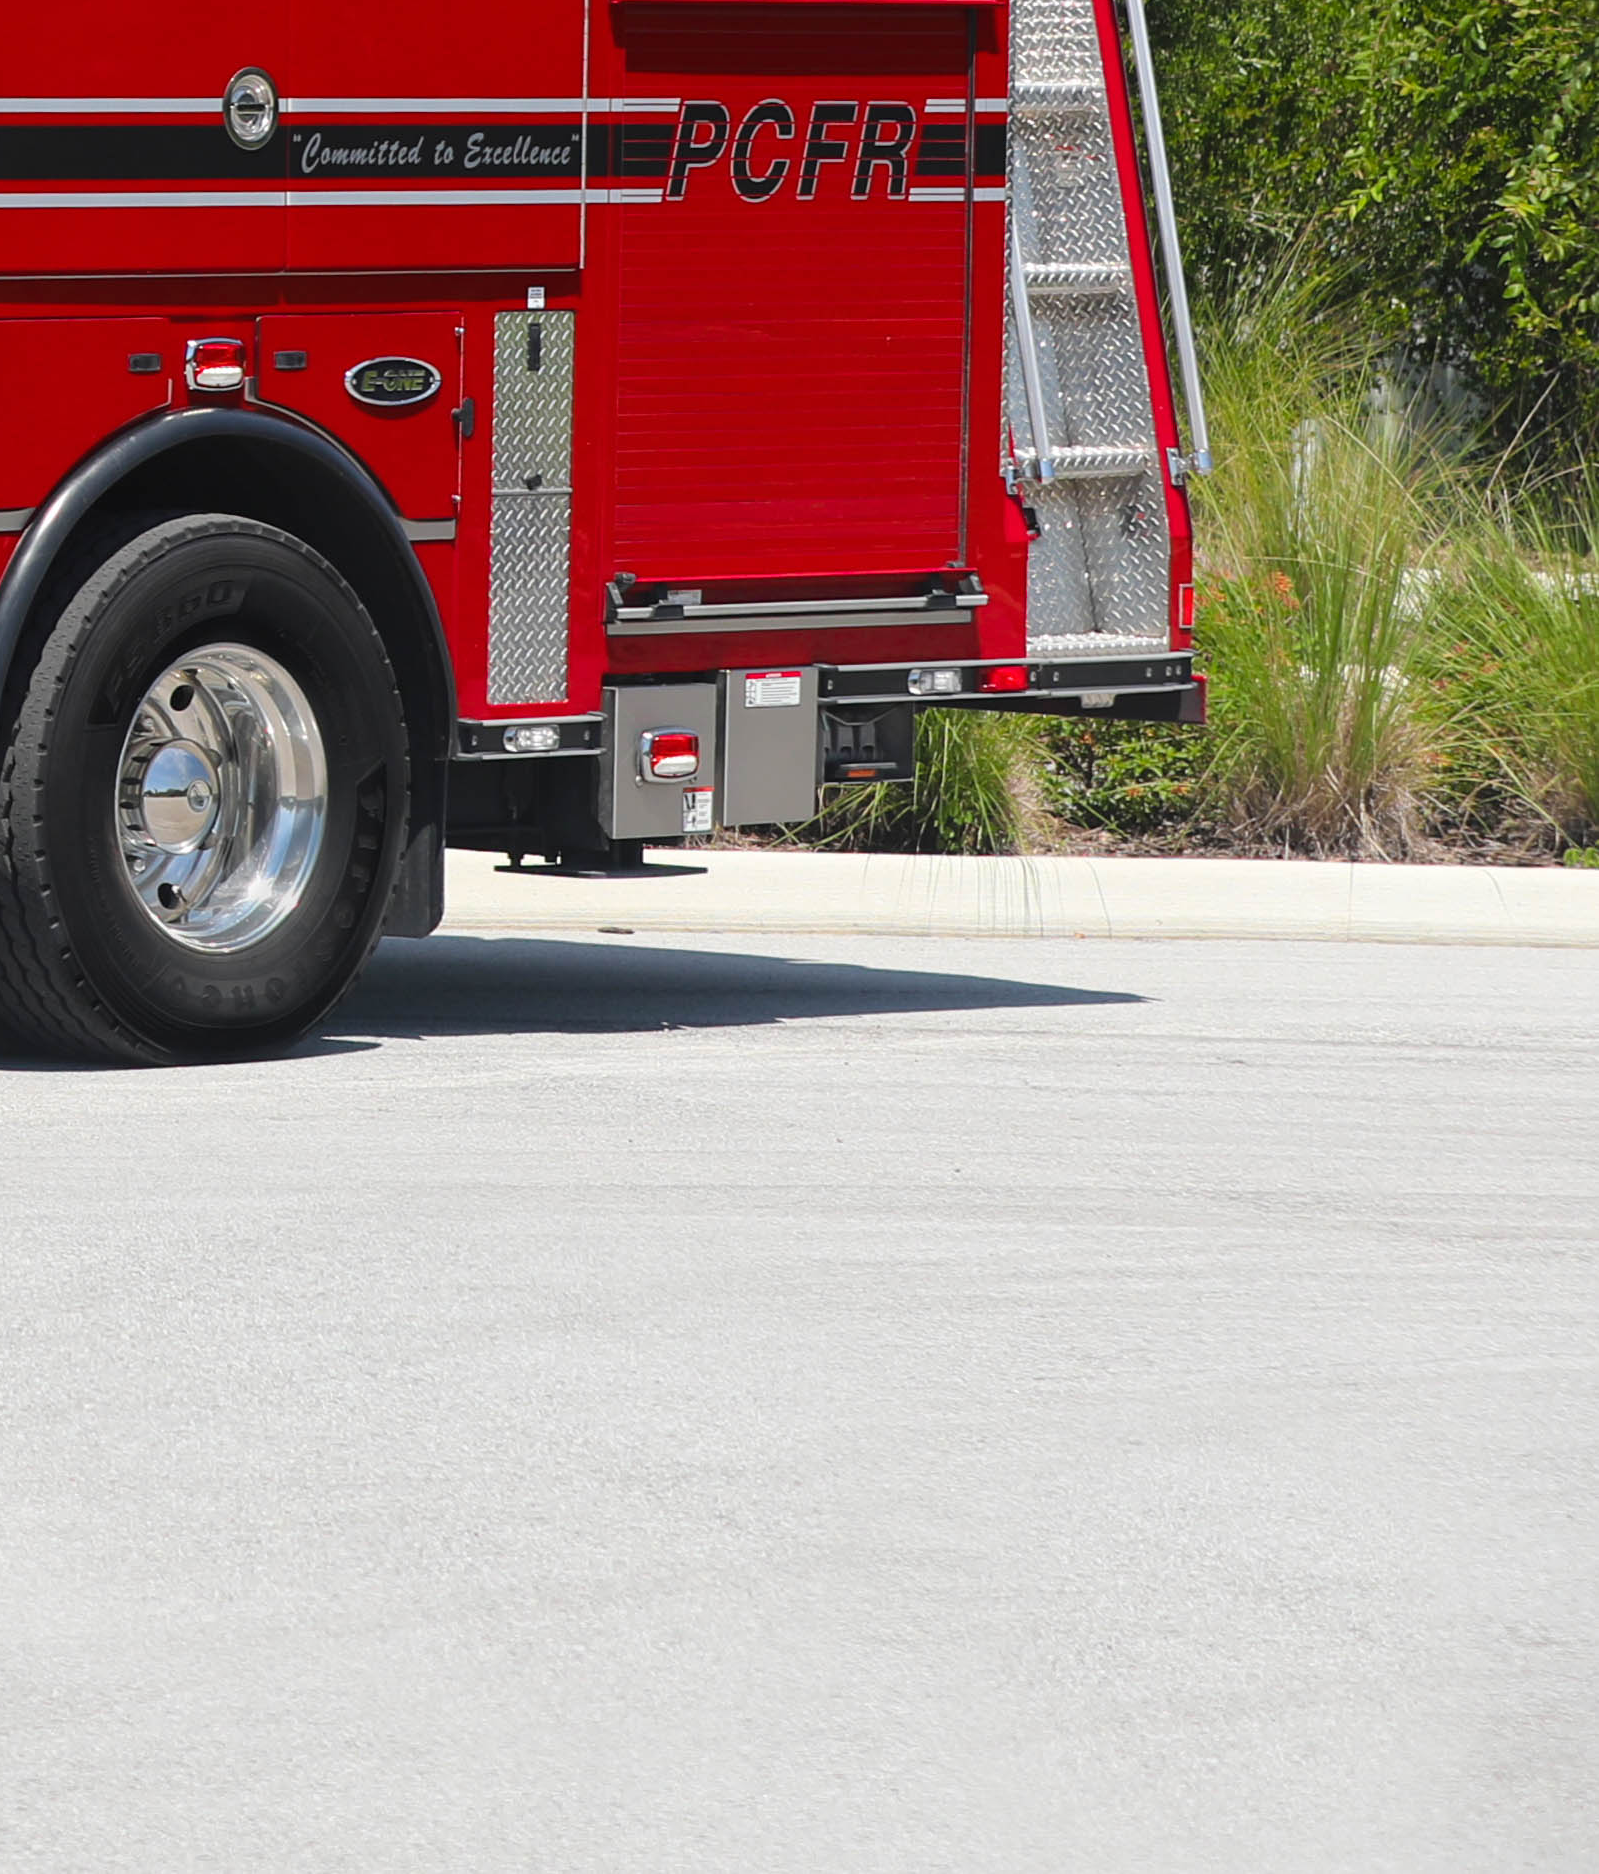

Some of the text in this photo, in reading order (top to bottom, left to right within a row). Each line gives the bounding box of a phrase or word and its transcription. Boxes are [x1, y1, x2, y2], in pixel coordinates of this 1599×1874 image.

[433, 139, 455, 165] to
[665, 97, 917, 203] PCFR
[361, 369, 426, 392] E-ONE
